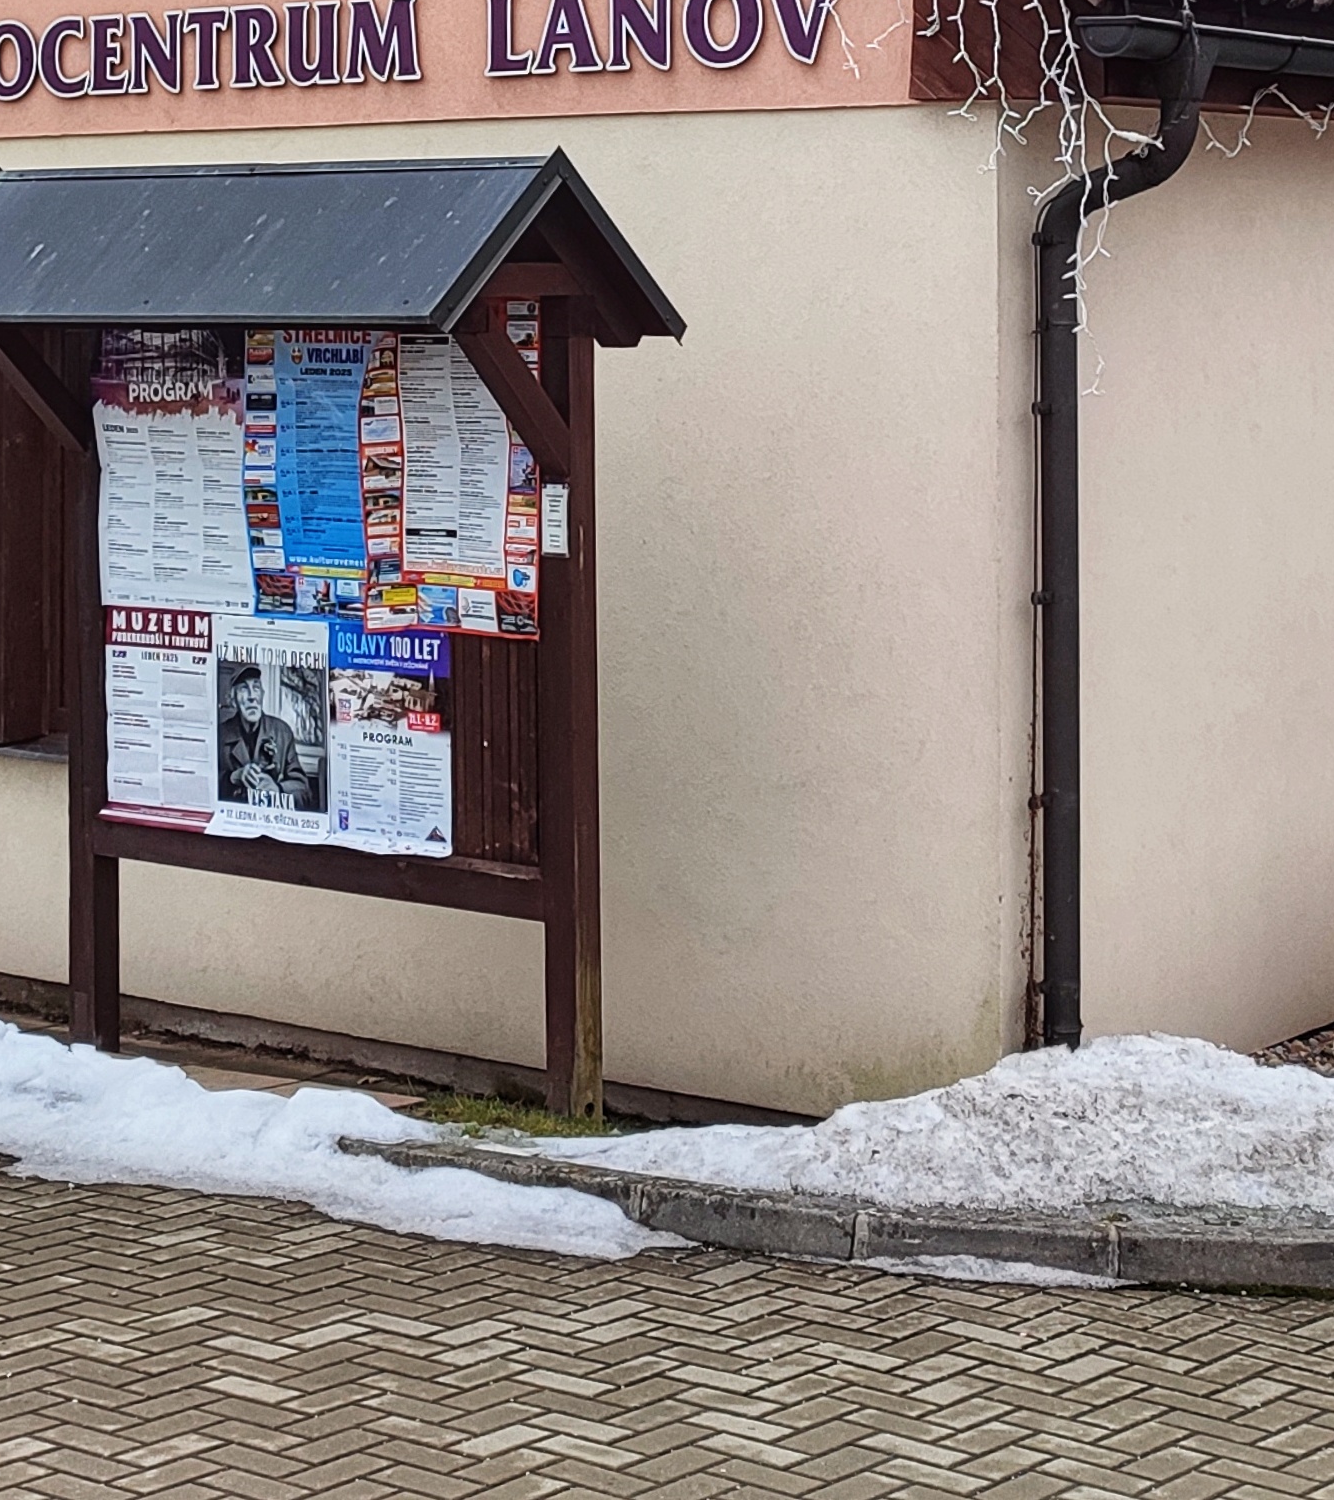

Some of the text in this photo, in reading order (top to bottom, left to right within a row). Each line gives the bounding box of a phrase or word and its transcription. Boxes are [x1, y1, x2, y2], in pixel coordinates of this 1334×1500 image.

[307, 345, 365, 364] VRCHLABÍ
[300, 367, 353, 377] LEDEN 2025
[128, 380, 213, 403] PROGRAM
[112, 609, 209, 636] MUZEUM
[337, 631, 386, 656] OSLAVY
[390, 636, 411, 658] 100
[414, 638, 441, 661] LET
[362, 731, 413, 748] PROGRAM
